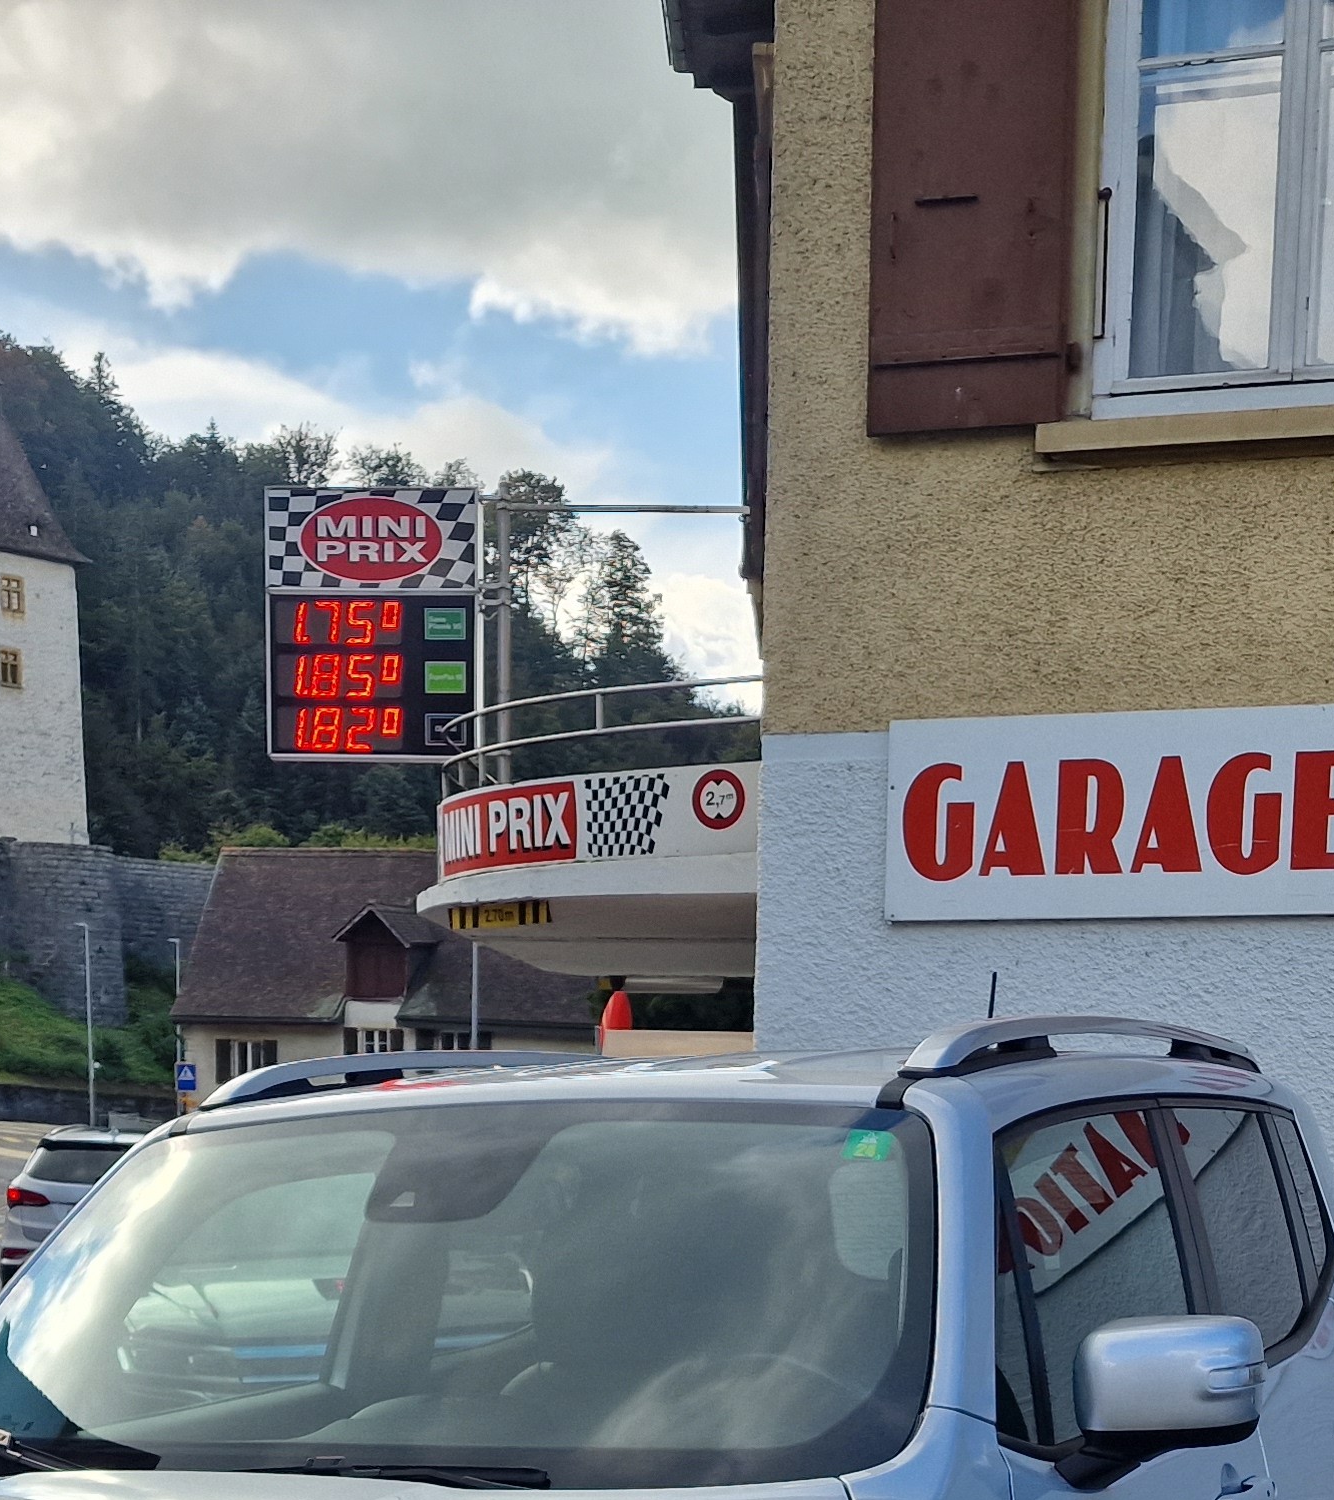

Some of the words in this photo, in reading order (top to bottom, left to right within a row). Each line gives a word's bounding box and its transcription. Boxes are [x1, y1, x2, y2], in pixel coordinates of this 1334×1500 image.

[316, 515, 427, 538] MINI
[316, 540, 428, 563] PRIX
[443, 803, 482, 865] MINI
[487, 791, 572, 857] PRIX
